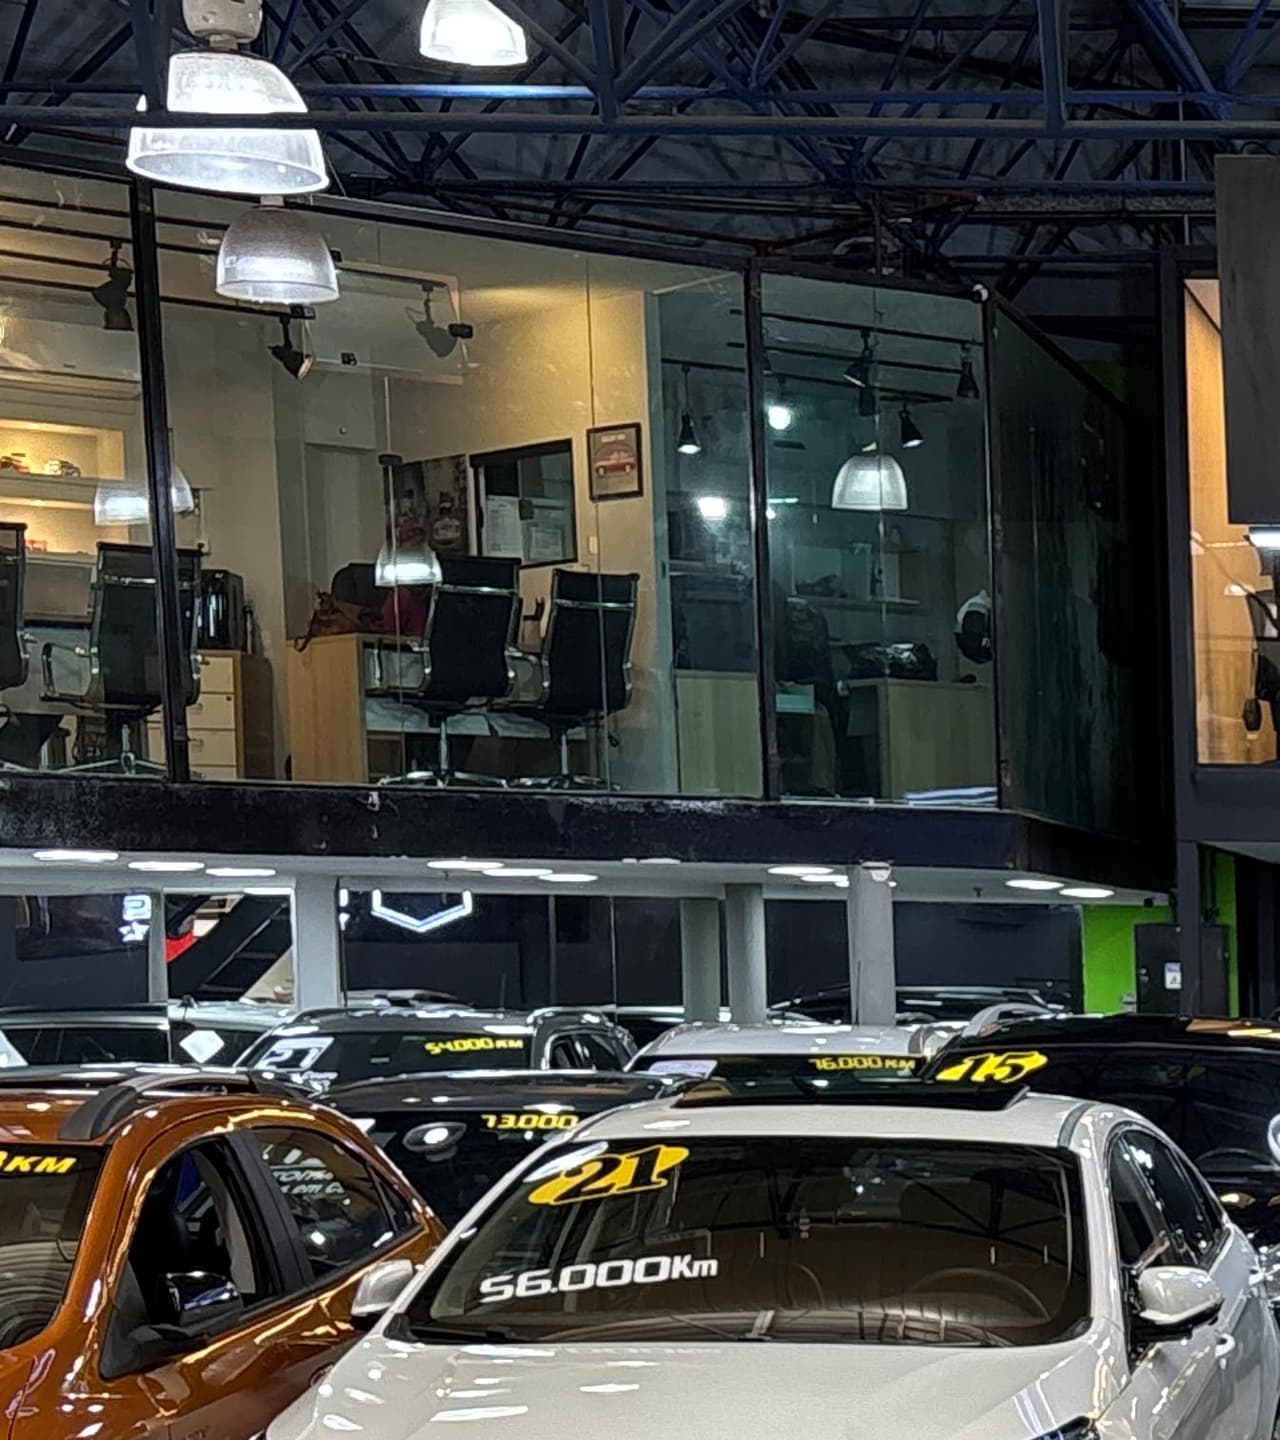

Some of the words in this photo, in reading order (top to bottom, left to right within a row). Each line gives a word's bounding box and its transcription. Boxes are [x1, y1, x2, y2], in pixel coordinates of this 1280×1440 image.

[957, 1050, 1041, 1083] 15
[545, 1145, 670, 1205] 21
[479, 1254, 718, 1303] 56.000Km
